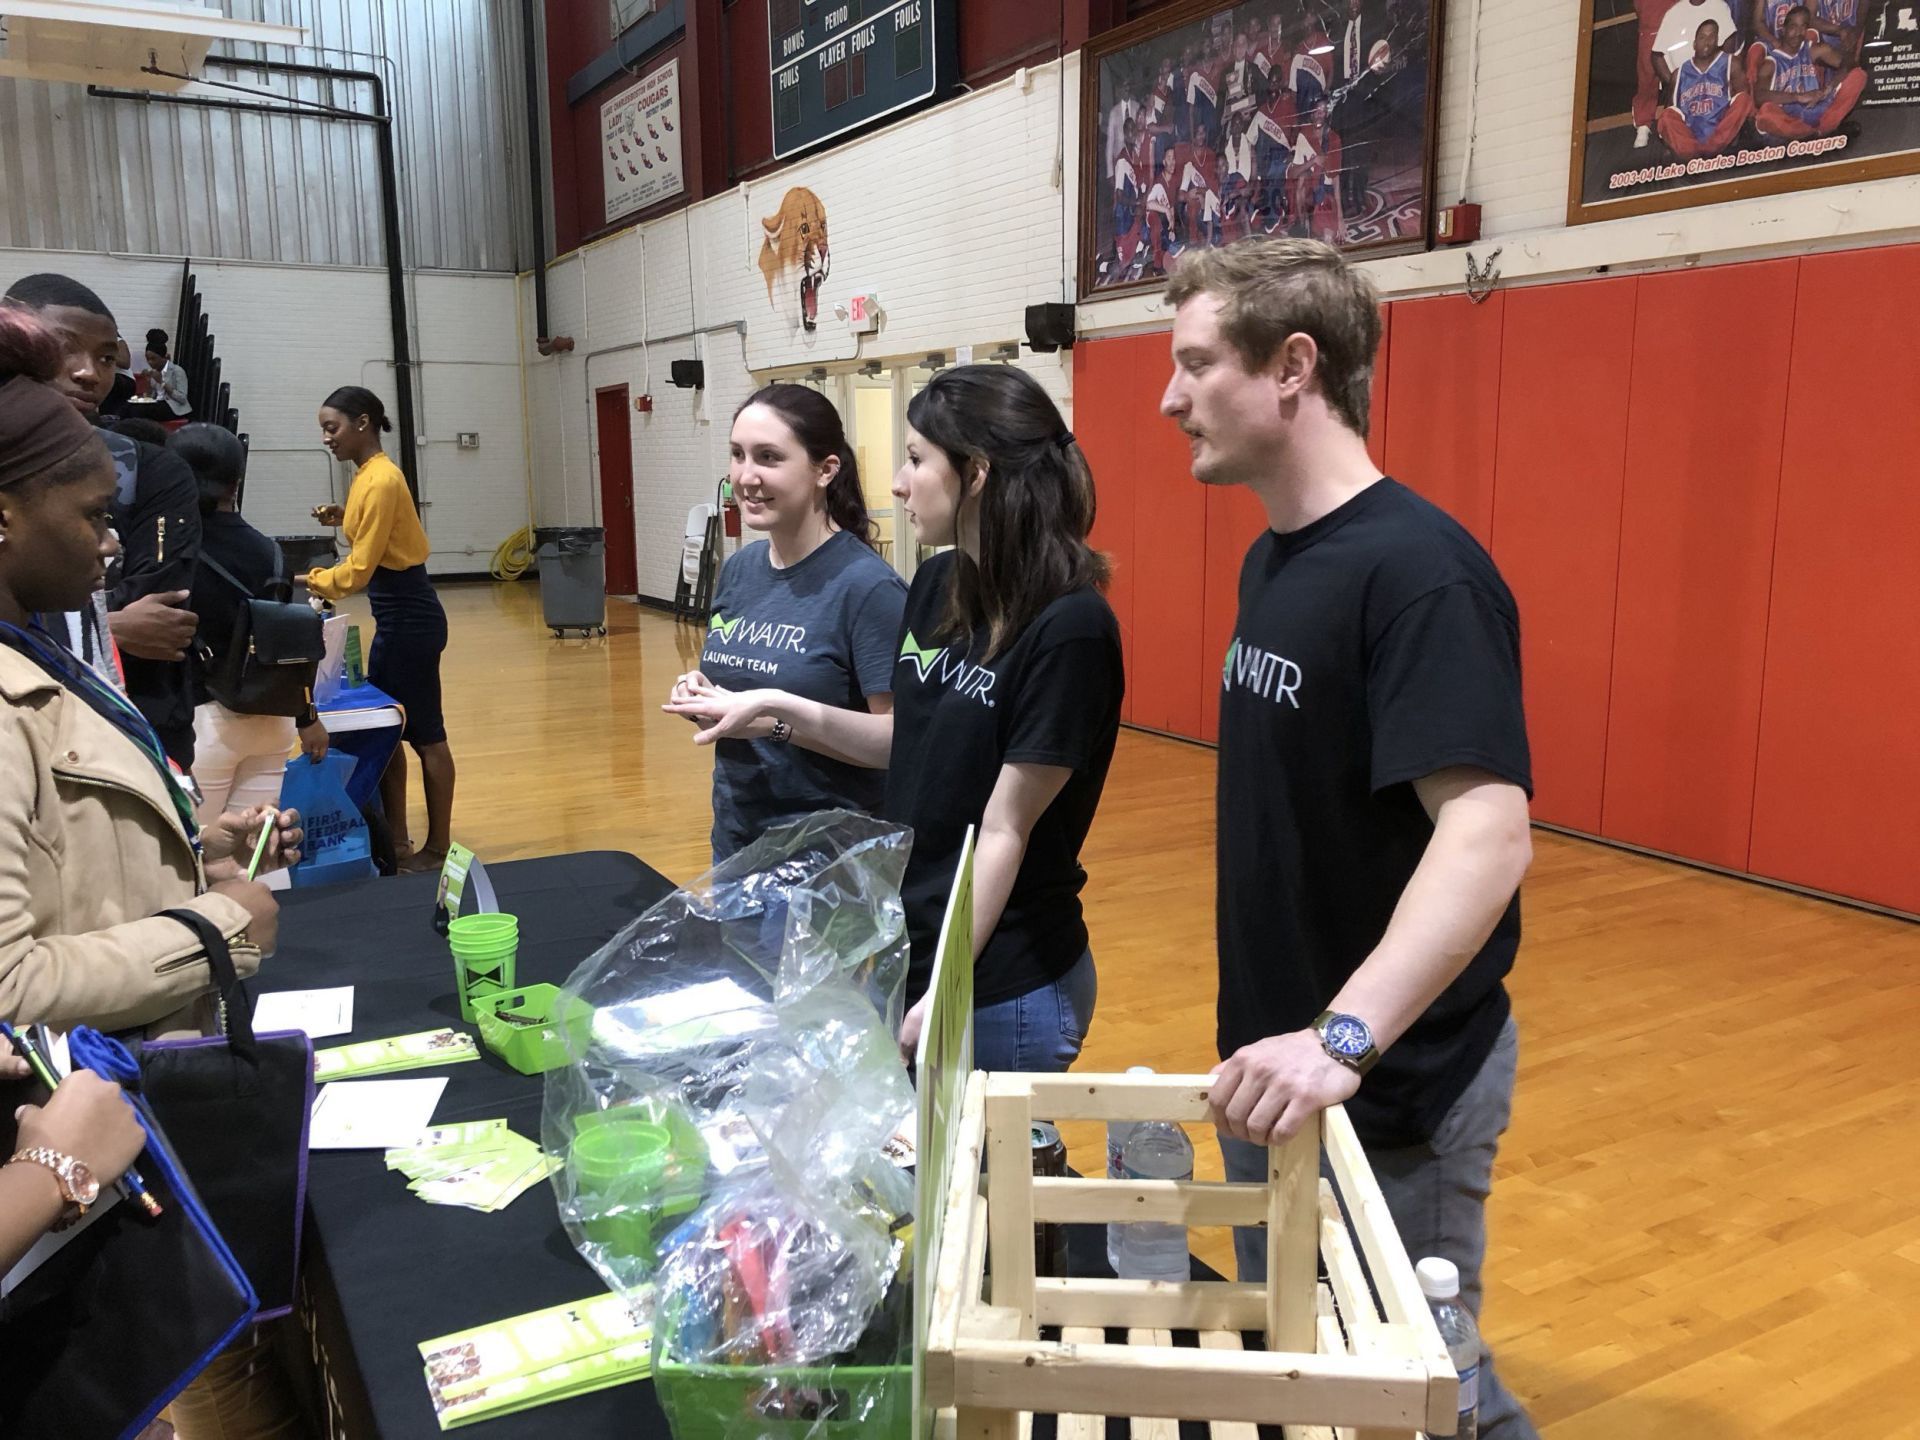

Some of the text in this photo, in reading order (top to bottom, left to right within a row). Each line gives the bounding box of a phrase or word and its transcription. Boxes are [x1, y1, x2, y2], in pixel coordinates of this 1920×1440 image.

[825, 5, 848, 32] PERIOD
[895, 1, 921, 32] FOULS
[783, 30, 805, 57] BONUS
[819, 25, 876, 71] PLAYER FOULS
[1892, 44, 1912, 53] BOY'S
[1869, 56, 1882, 64] TOP
[779, 65, 800, 91] FOULS
[1886, 76, 1906, 84] CAJUN
[608, 85, 669, 130] LADY COUGARS
[1609, 134, 1848, 190] 2003-04 Lake Charles Boston Cougars
[702, 650, 779, 675] LAUNCH TEAM
[307, 810, 343, 829] FIRST
[307, 817, 366, 839] FEDERAL
[307, 834, 347, 852] BANK
